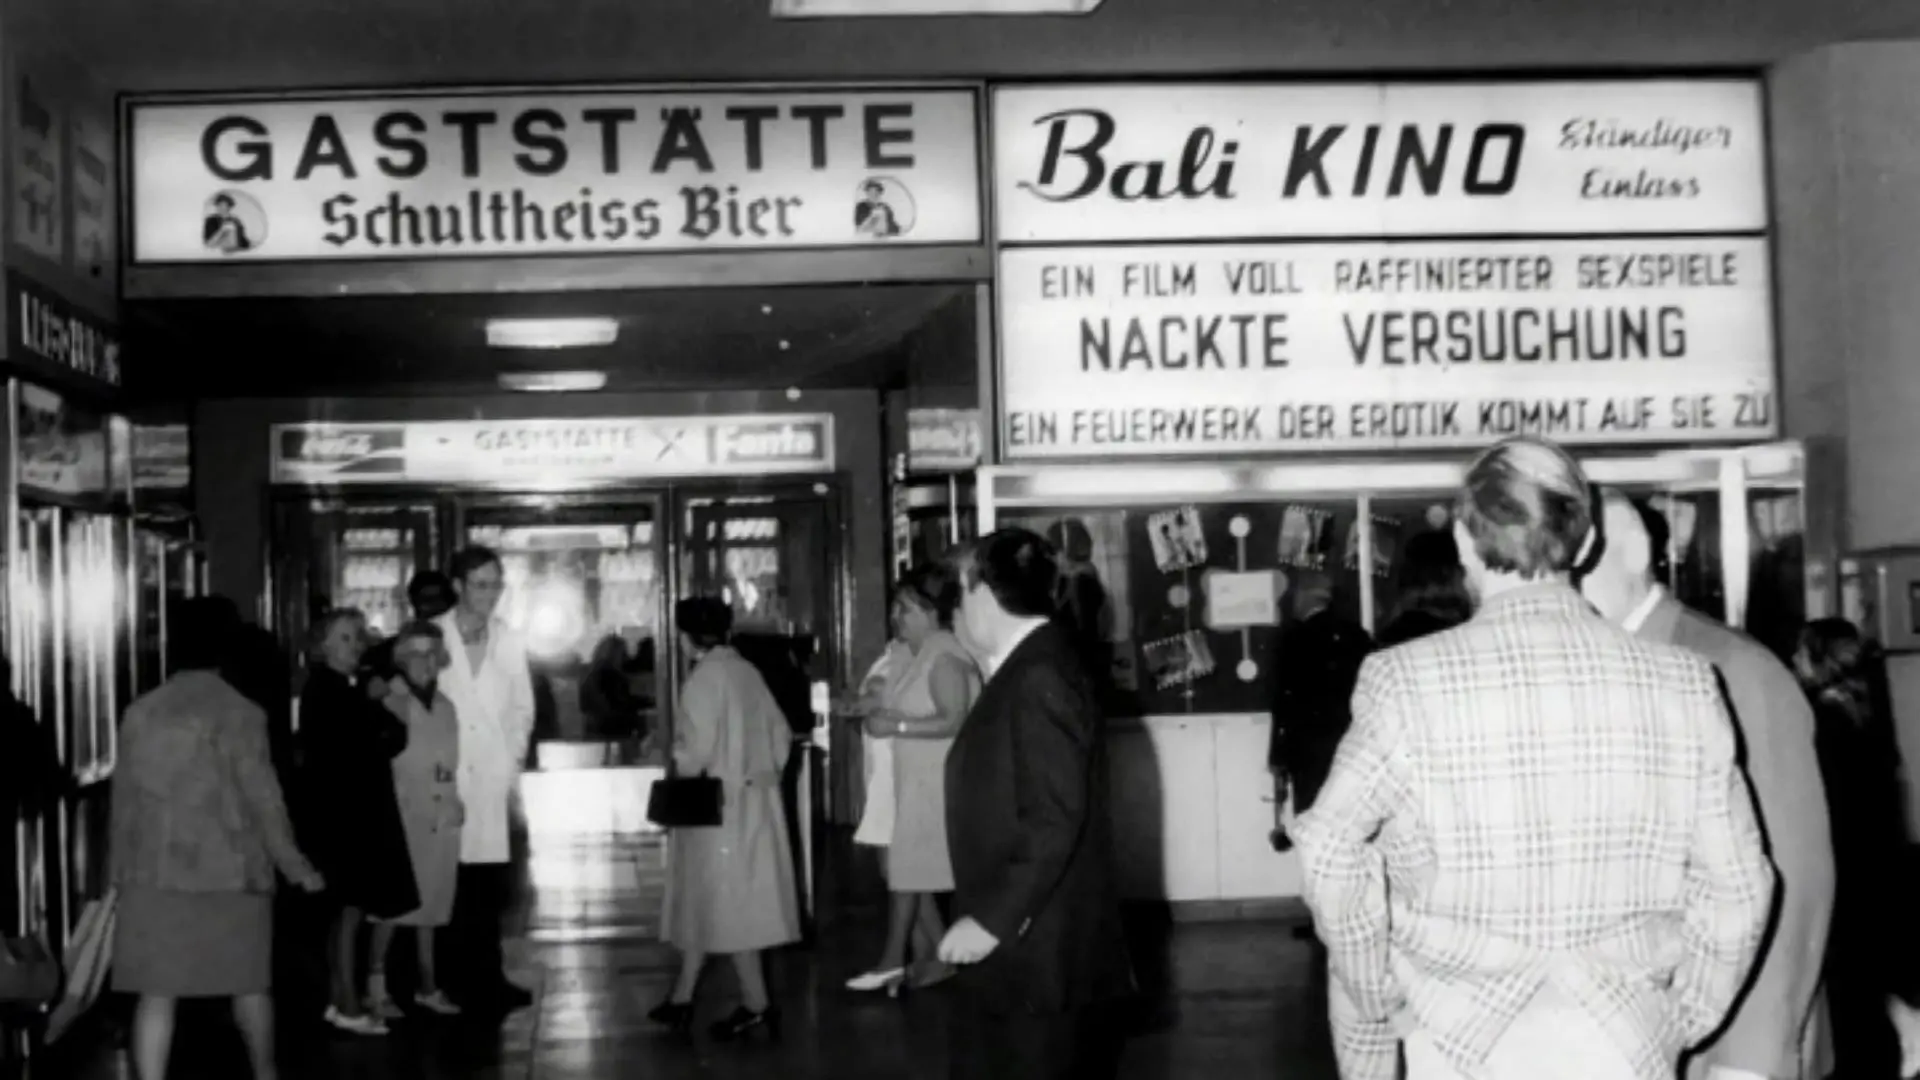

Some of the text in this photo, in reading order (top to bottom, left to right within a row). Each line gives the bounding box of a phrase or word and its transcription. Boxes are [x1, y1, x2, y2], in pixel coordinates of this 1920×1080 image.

[202, 103, 915, 181] GASTSTÄTTE
[1017, 108, 1525, 202] Bali KINO
[1580, 166, 1701, 199] Einlass
[322, 184, 804, 246] Schultheiss Bier
[1041, 252, 1739, 298] EIN FILM VOLL RAFFINIERTER SEXSPIELE
[1079, 305, 1687, 371] NACKTE VERSUCHUNG
[1009, 411, 1057, 446] EIN
[1071, 406, 1262, 445] FEUERWERK
[1278, 404, 1334, 440] DER
[1350, 400, 1460, 439] EROTIK
[1477, 398, 1590, 435] KOMMT
[1599, 397, 1655, 432] AUF
[1671, 394, 1715, 430] SIE
[1734, 393, 1772, 428] ZU
